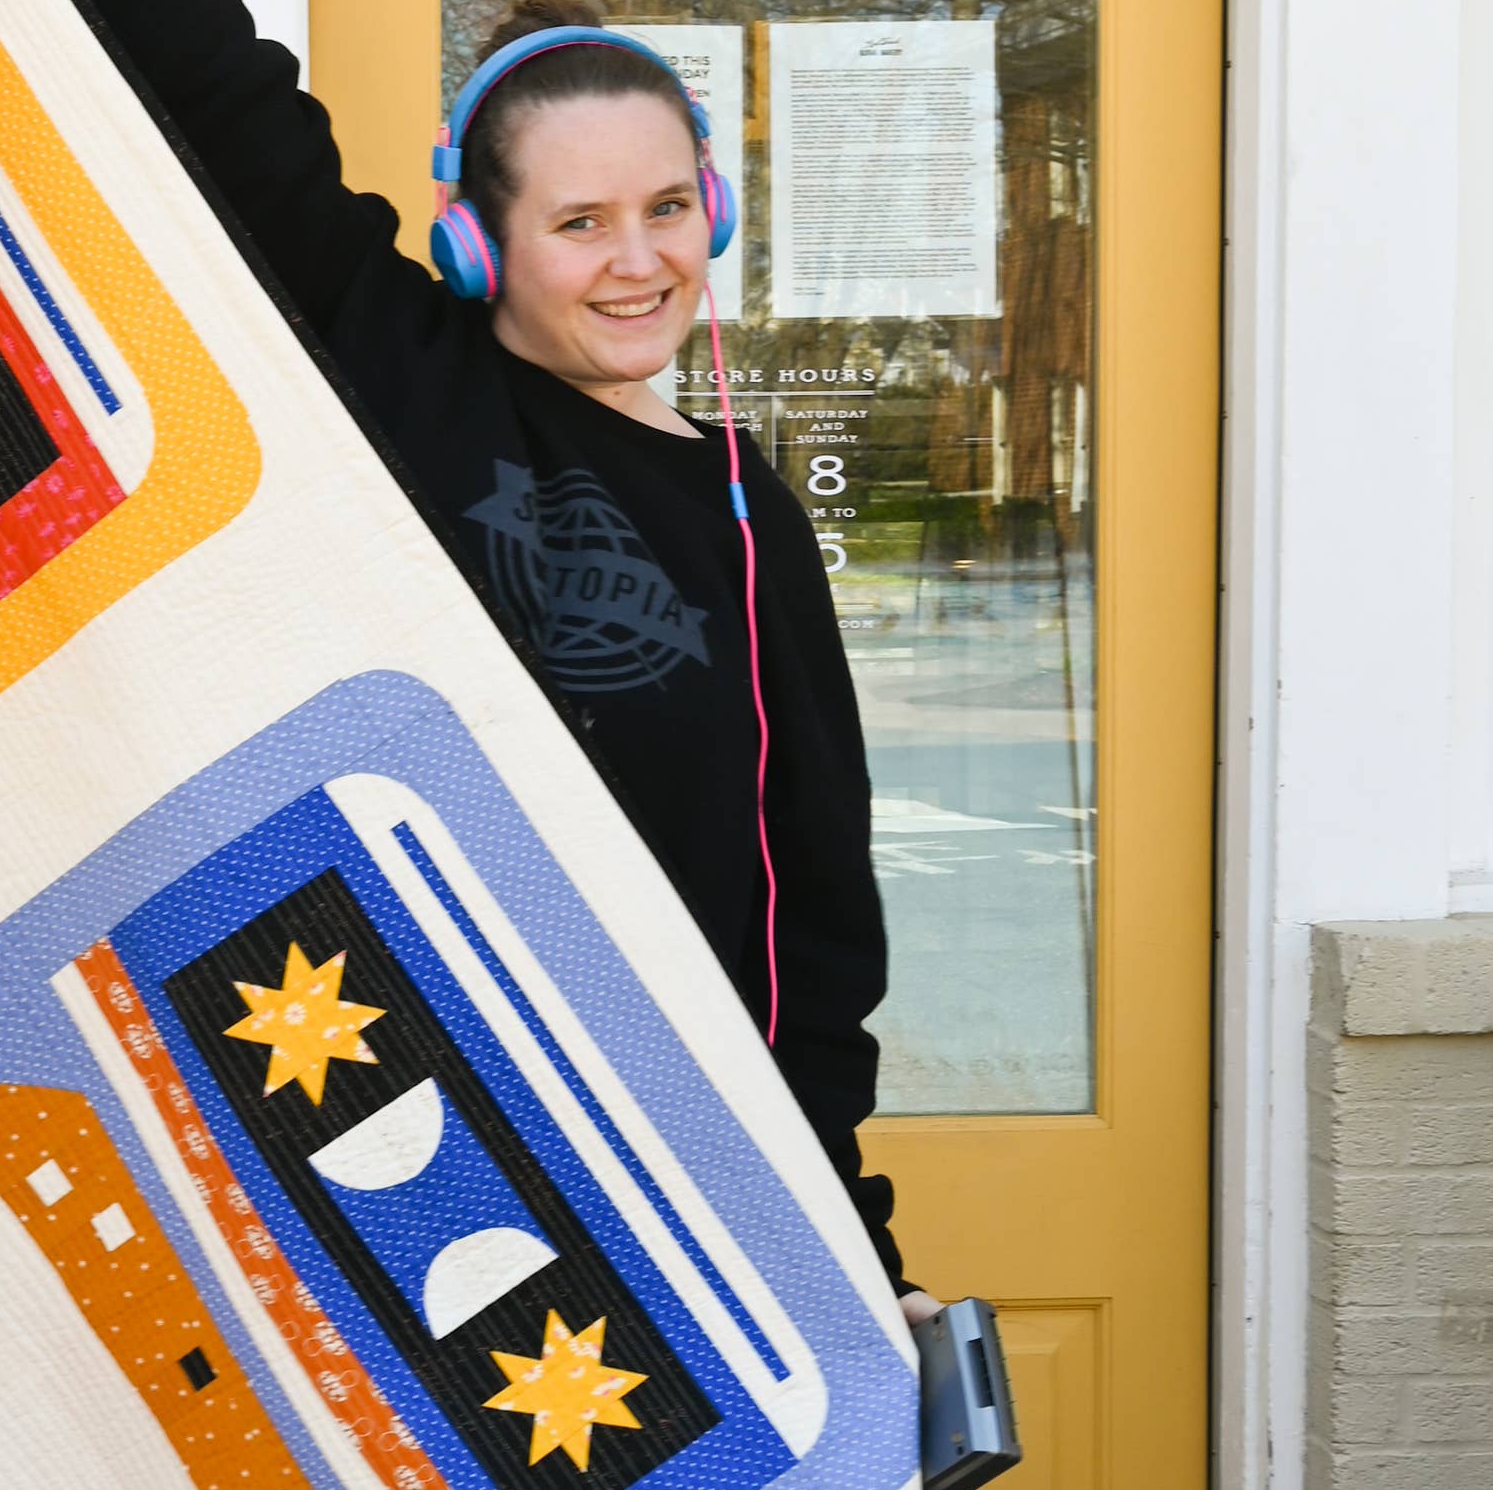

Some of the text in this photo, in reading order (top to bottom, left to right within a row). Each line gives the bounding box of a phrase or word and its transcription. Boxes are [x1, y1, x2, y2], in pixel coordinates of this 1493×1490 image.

[683, 55, 710, 65] THIS
[674, 368, 876, 384] STORE HOURS
[785, 410, 869, 419] SATURDAY
[809, 422, 845, 431] AND
[795, 435, 859, 444] SUNDAY
[807, 454, 847, 496] 8
[832, 507, 857, 518] TO
